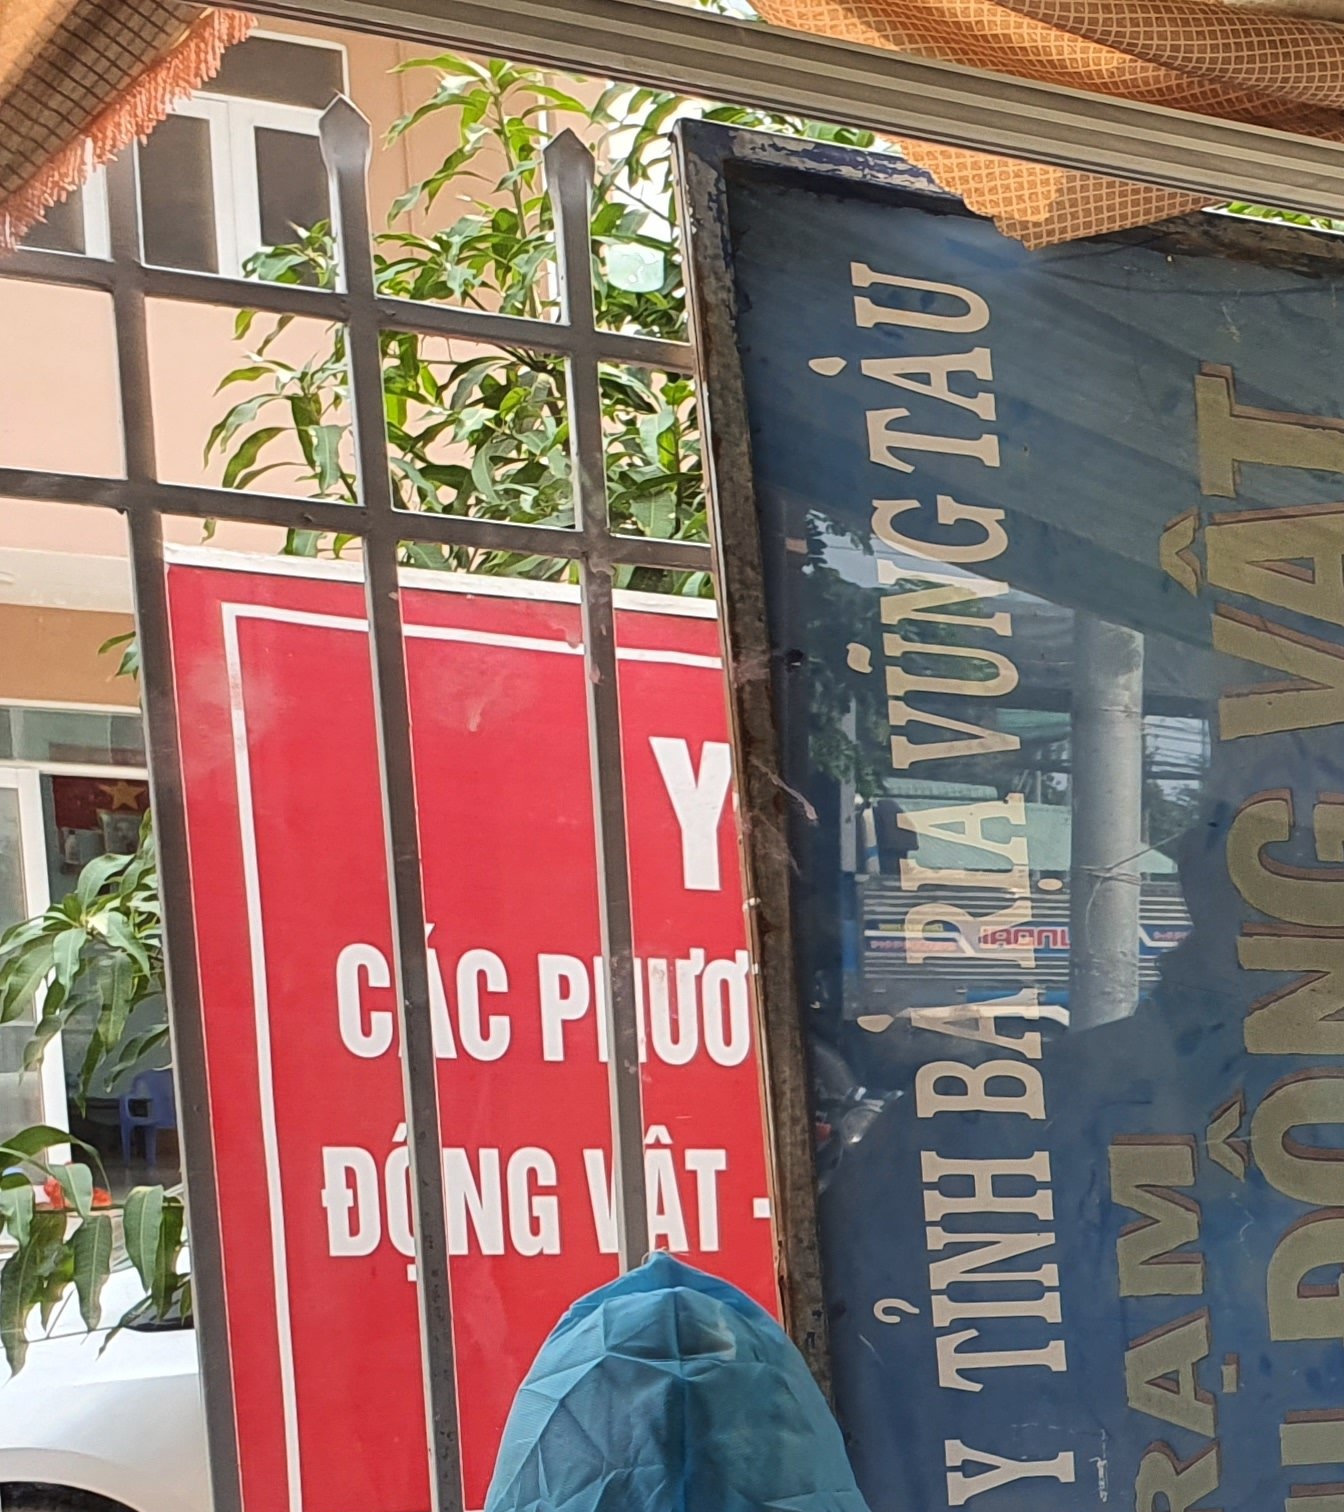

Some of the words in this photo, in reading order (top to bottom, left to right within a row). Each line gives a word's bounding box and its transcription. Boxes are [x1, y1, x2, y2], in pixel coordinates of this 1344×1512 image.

[809, 261, 1000, 473] TÀU
[846, 495, 1021, 769] VŨNG
[897, 792, 1062, 968] RỊA
[321, 1122, 560, 1281] ĐỘNG
[873, 1151, 1067, 1393] TỈNH
[946, 1440, 1076, 1505] Y
